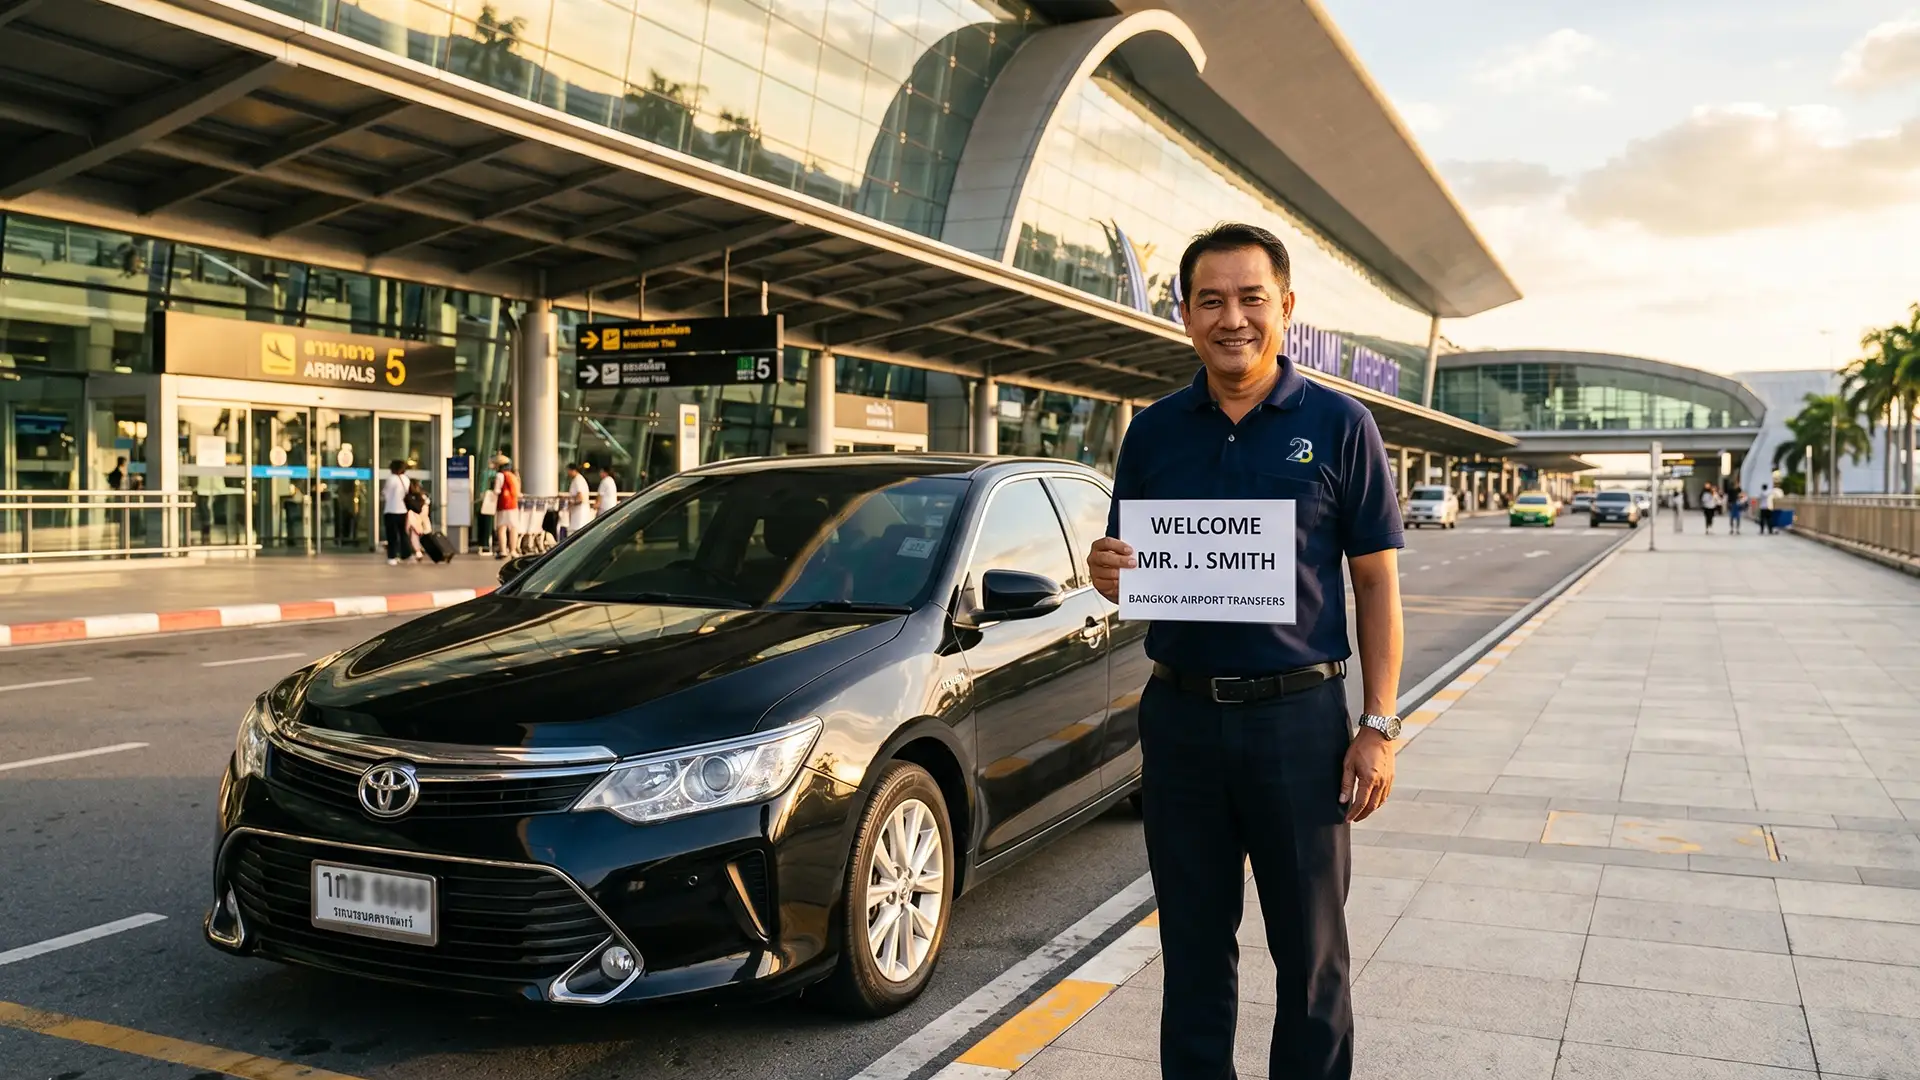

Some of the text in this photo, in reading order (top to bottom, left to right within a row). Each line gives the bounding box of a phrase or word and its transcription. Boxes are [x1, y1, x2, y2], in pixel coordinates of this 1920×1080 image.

[304, 361, 376, 384] ARRIVALS
[385, 348, 406, 386] 5
[756, 357, 770, 379] 5
[1150, 516, 1262, 535] WELCOME
[1137, 551, 1276, 571] MR. J. SMITH
[1128, 594, 1285, 607] BANGKOK AIRPORT TRANSFERS
